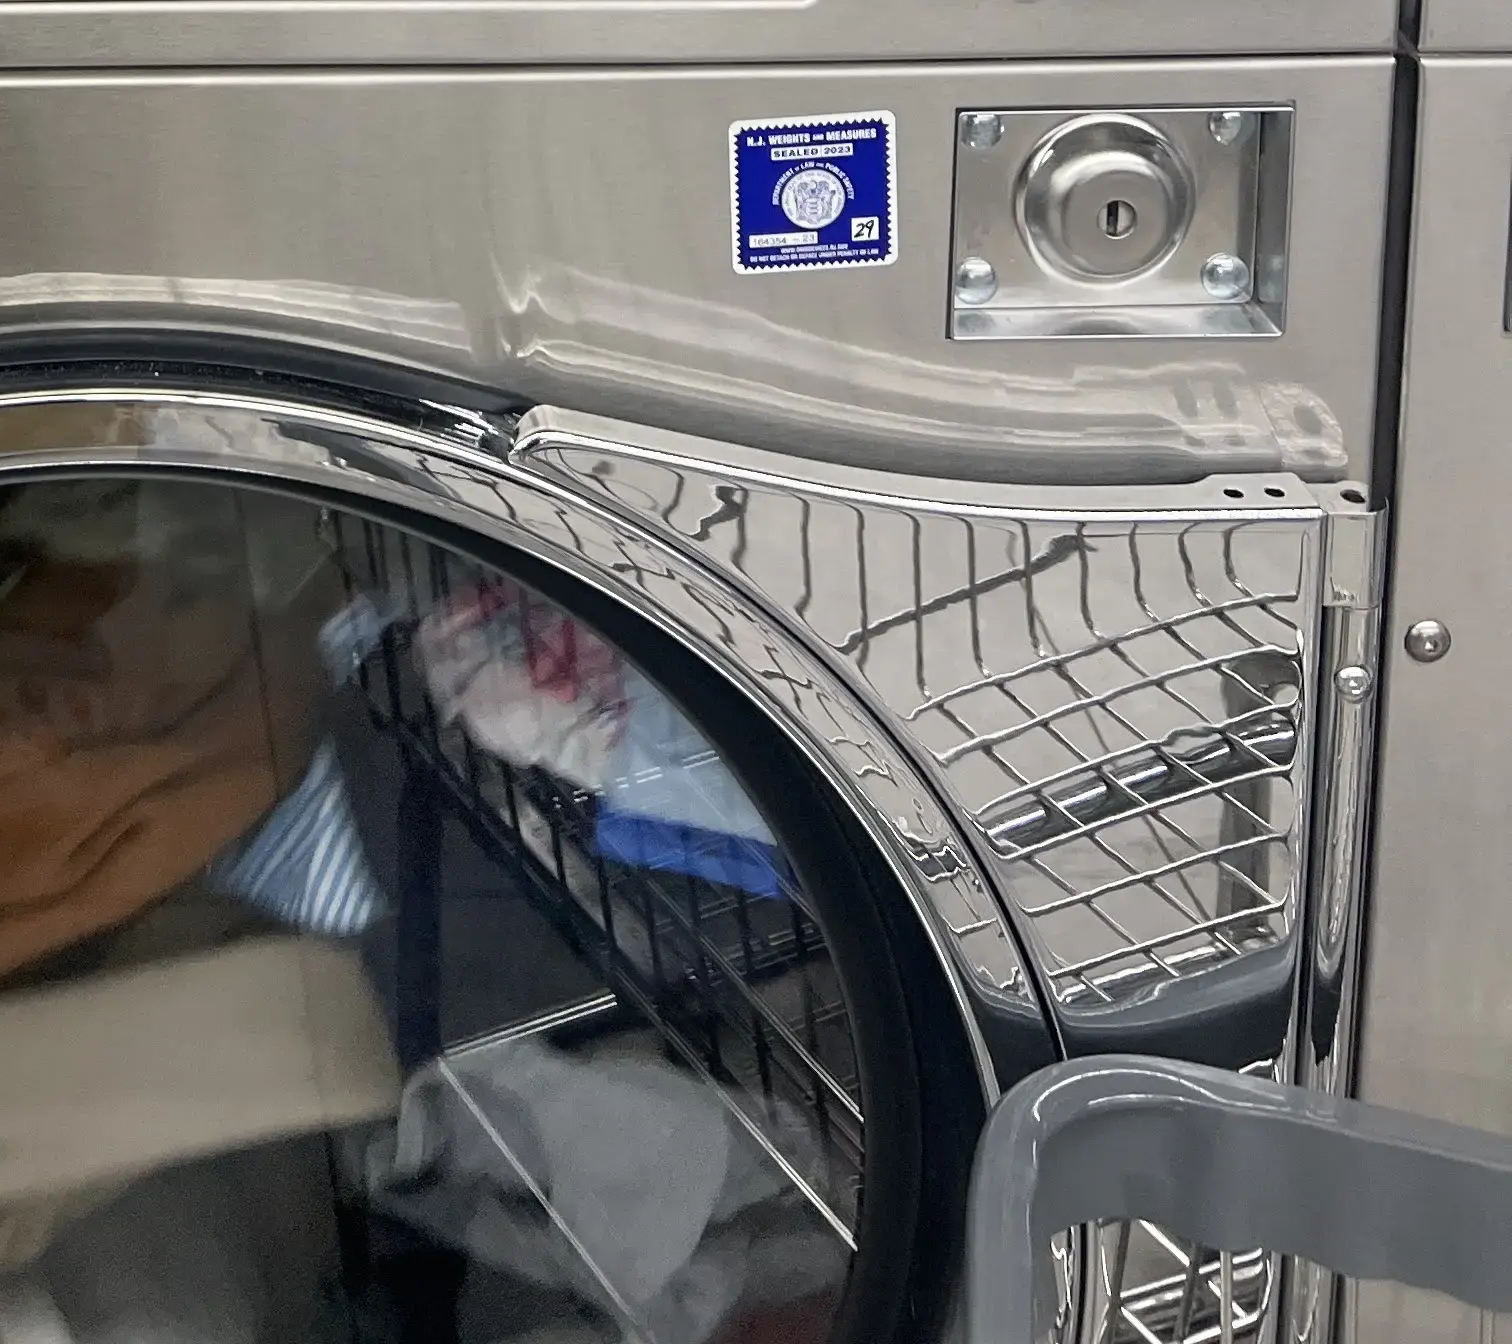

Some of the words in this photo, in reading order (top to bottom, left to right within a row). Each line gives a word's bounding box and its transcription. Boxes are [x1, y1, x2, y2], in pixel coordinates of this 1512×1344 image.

[747, 136, 766, 147] N.J.
[768, 133, 811, 145] WEIGHTS
[826, 128, 877, 141] MEASURES
[774, 148, 818, 158] SEALED
[824, 145, 851, 154] 2023
[854, 220, 875, 239] 29
